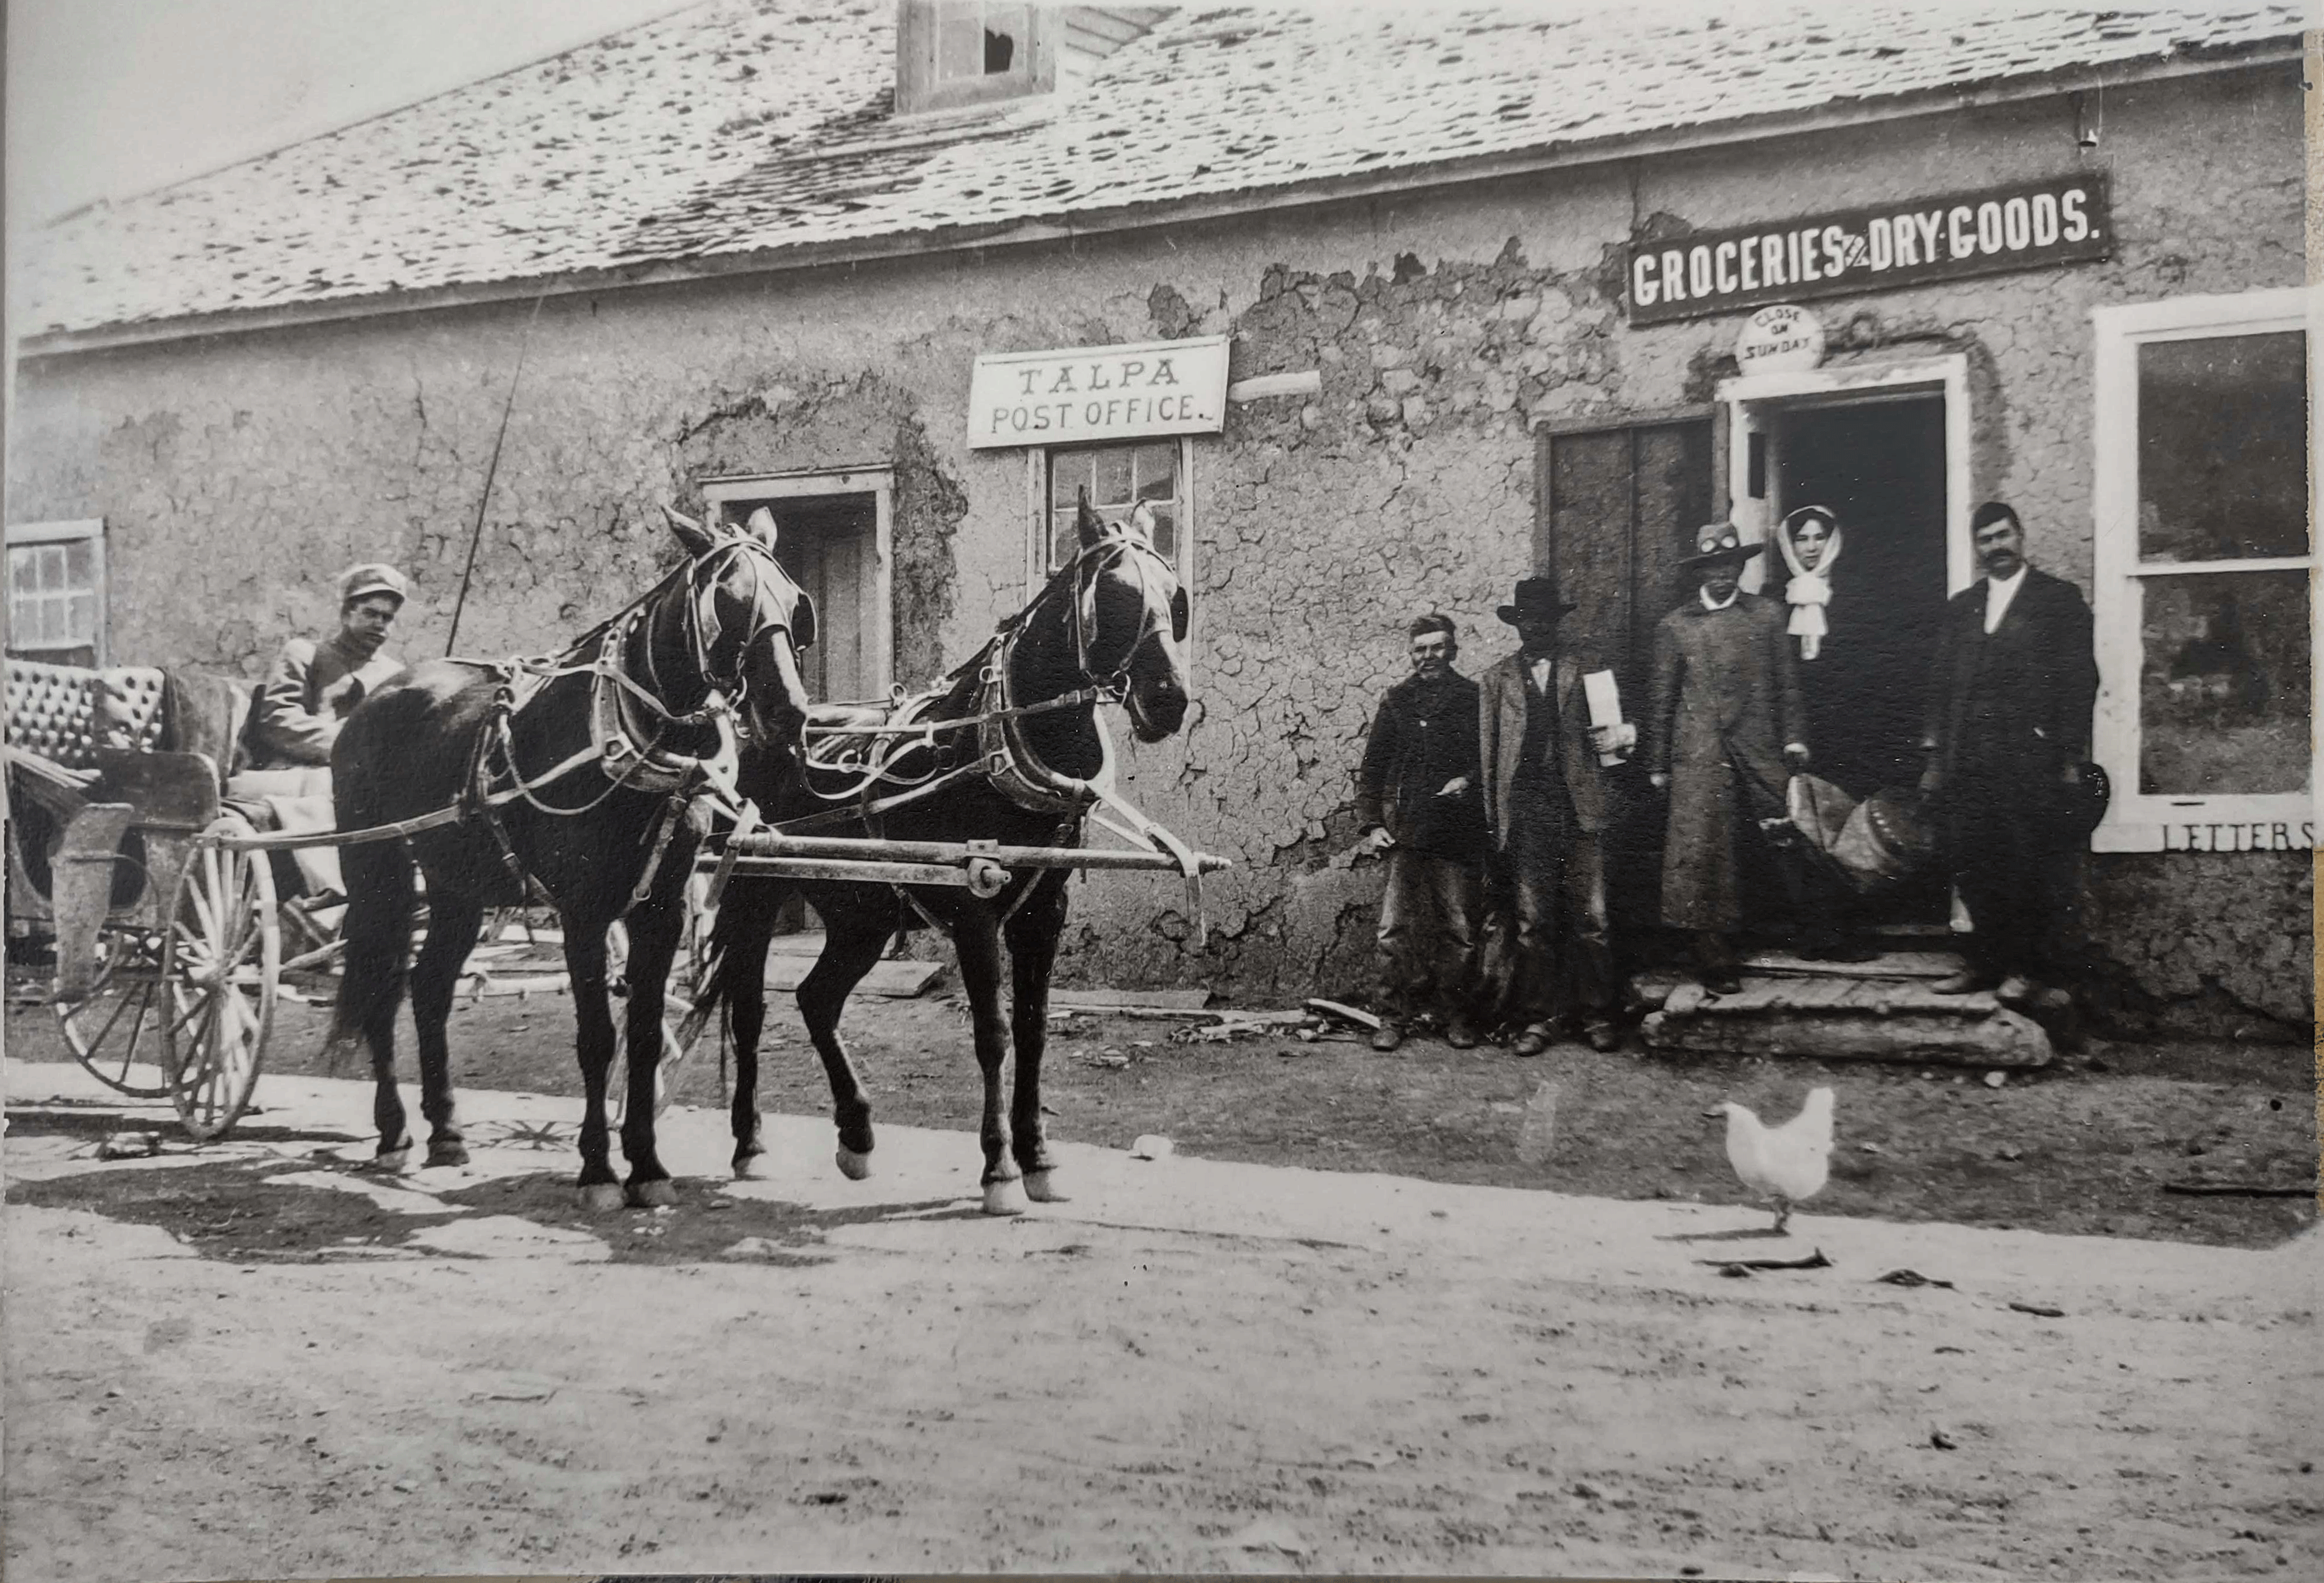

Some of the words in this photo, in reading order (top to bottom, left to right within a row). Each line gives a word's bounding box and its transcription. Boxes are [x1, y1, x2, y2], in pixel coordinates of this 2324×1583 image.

[1633, 225, 1845, 307] GROCERIES
[1744, 336, 1811, 359] SUNDAY
[1019, 358, 1180, 395] TALPA
[990, 403, 1073, 434] POST
[2162, 822, 2314, 852] LETTERS
